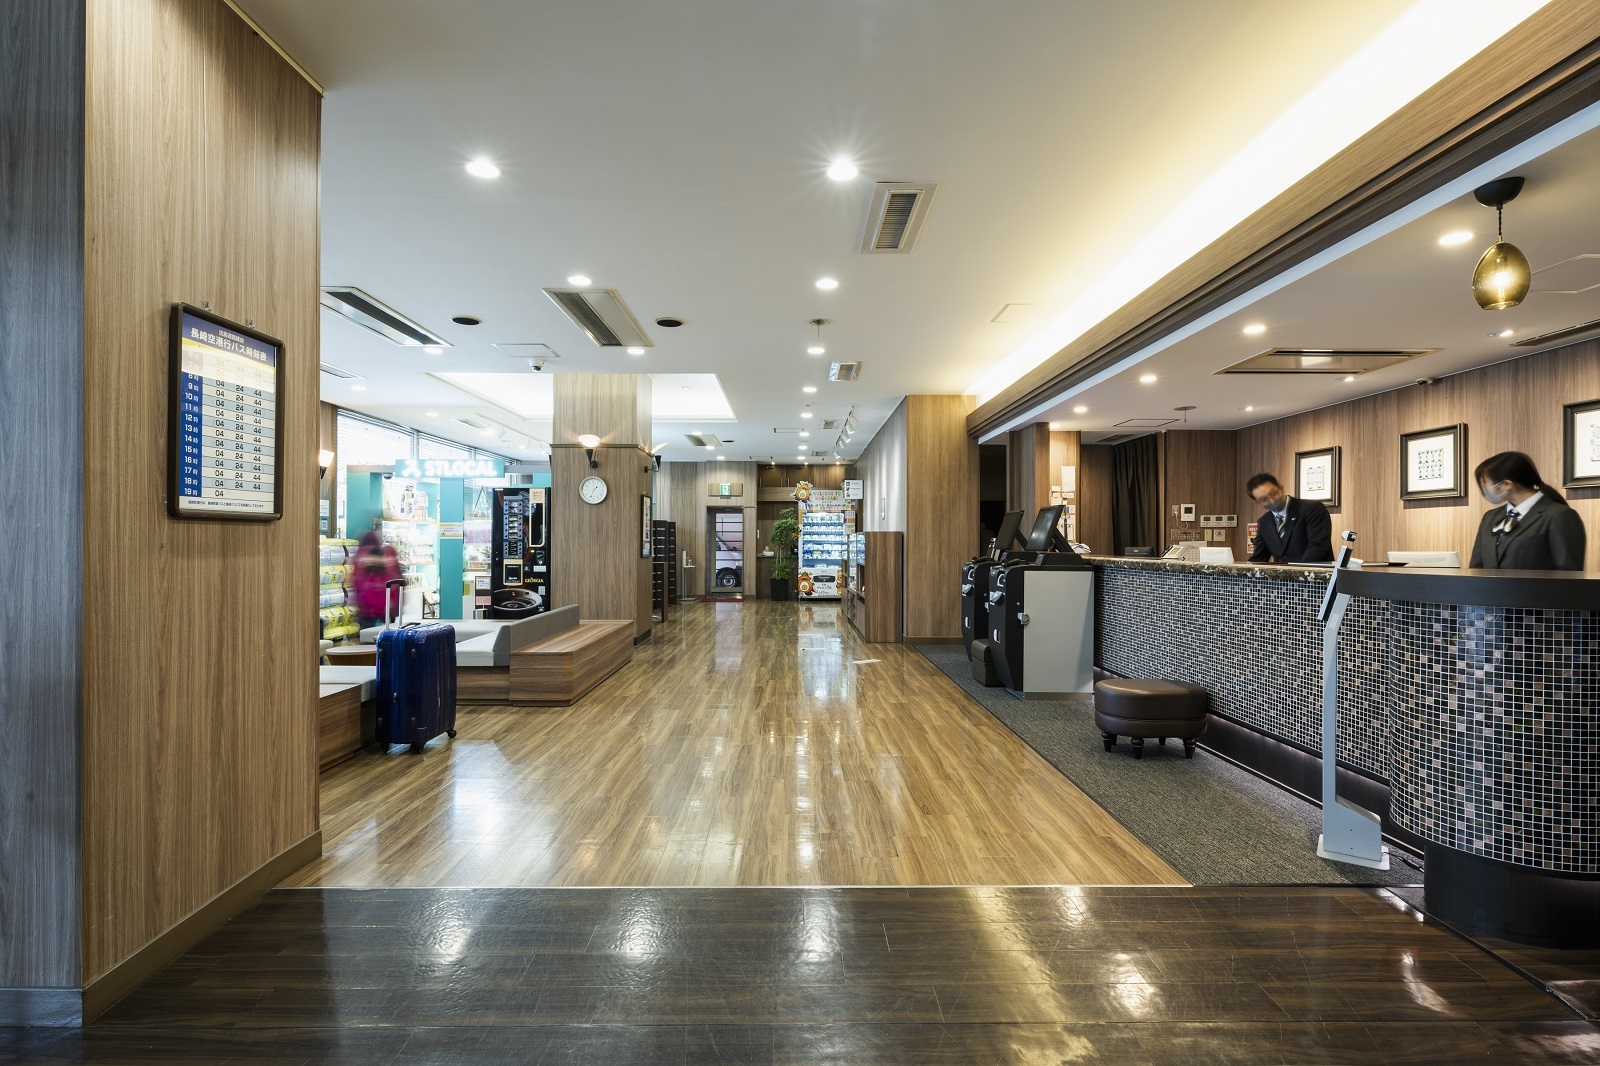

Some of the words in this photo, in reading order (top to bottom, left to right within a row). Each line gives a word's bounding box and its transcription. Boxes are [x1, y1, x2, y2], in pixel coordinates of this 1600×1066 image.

[190, 327, 267, 362] 長崎空港行バス時刻表
[425, 460, 497, 476] STLOCAL
